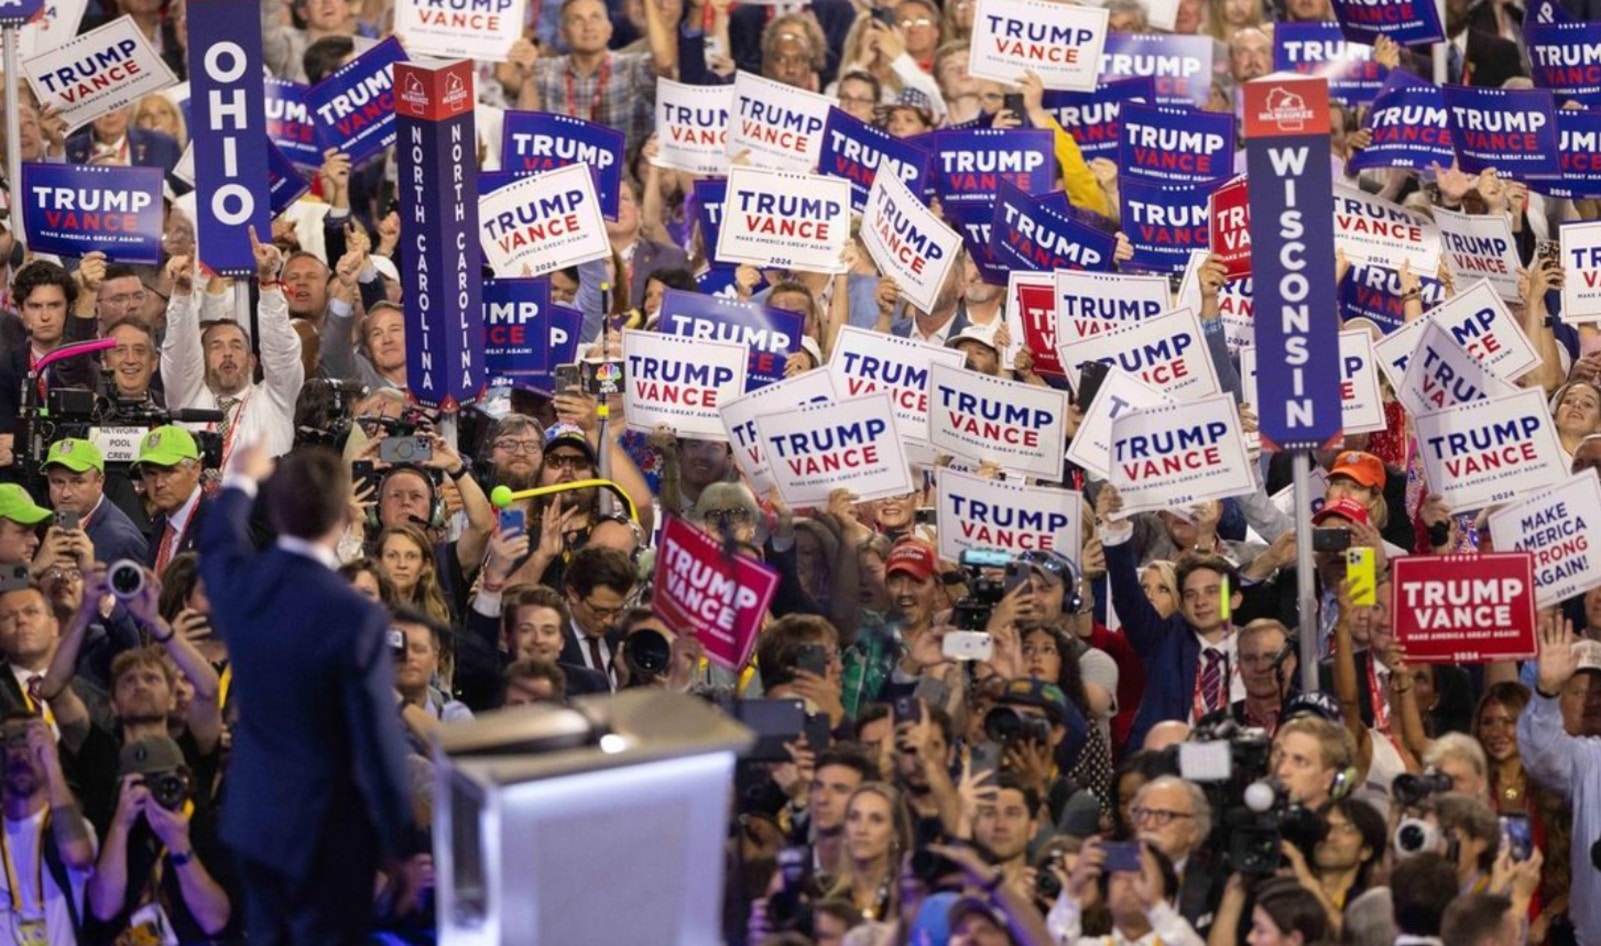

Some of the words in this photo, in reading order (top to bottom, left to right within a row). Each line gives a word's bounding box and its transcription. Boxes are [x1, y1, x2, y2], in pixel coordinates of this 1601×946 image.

[418, 9, 500, 31] VANCE
[986, 15, 1094, 47] TRUMP
[39, 39, 136, 92] TRUMP
[995, 38, 1079, 64] VANCE
[1283, 40, 1371, 61] TRUM
[1535, 44, 1601, 66] TRUM
[59, 60, 140, 103] VANCE
[336, 93, 396, 139] VANC
[740, 96, 823, 135] TRUMP
[1373, 105, 1448, 128] TRUM
[1452, 107, 1546, 132] TRUMP
[204, 41, 254, 226] OHIO
[741, 120, 808, 153] VANCE
[1126, 123, 1224, 155] TRUMP
[1465, 131, 1537, 150] VANCE
[512, 133, 614, 170] TRUMP
[940, 151, 1045, 173] TRUMP
[1135, 147, 1211, 172] VANCE
[411, 126, 425, 224] NORTH
[451, 123, 464, 222] NORTH
[951, 174, 1031, 191] VANE
[33, 186, 151, 213] TRUMP
[484, 189, 584, 241] TRUMP
[737, 190, 840, 221] TRUMP
[1128, 200, 1209, 227] TRUM
[46, 211, 138, 231] VANCE
[499, 214, 580, 254] VANCE
[746, 215, 829, 241] VANCE
[877, 184, 943, 260] TRUMP
[1003, 201, 1101, 267] TRUMP
[1141, 226, 1208, 243] VANC
[1337, 214, 1422, 242] VANCE
[876, 210, 926, 275] VANCE
[1442, 230, 1507, 256] TRUMP
[535, 261, 557, 272] 2024
[769, 256, 792, 266] 2024
[1368, 255, 1389, 264] 2024
[1453, 254, 1508, 274] VANCE
[1267, 147, 1314, 428] WISCONSIN
[416, 234, 434, 391] CAROLINA
[456, 232, 472, 389] CAROLINA
[1064, 295, 1161, 321] TRUMP
[629, 355, 733, 387] TRUMP
[844, 352, 929, 391] TRUM
[637, 381, 717, 408] VANCE
[938, 385, 1053, 430] TRUMP
[109, 438, 131, 447] POOL
[769, 418, 885, 458] TRUMP
[949, 411, 1038, 447] VANCE
[1115, 421, 1227, 462] TRUMP
[1428, 415, 1540, 460] TRUMP
[107, 451, 132, 459] CREW
[788, 445, 879, 477] VANCE
[1123, 446, 1221, 481] VANCE
[1445, 443, 1538, 478] VANCE
[949, 494, 1068, 533] TRUMP
[1168, 494, 1193, 506] 2024
[1521, 502, 1568, 533] MAKE
[960, 520, 1053, 550] VANCE
[665, 538, 758, 610] TRUMP
[667, 568, 736, 631] VANCE
[1402, 578, 1523, 607] TRUMP
[1415, 605, 1512, 629] VANCE
